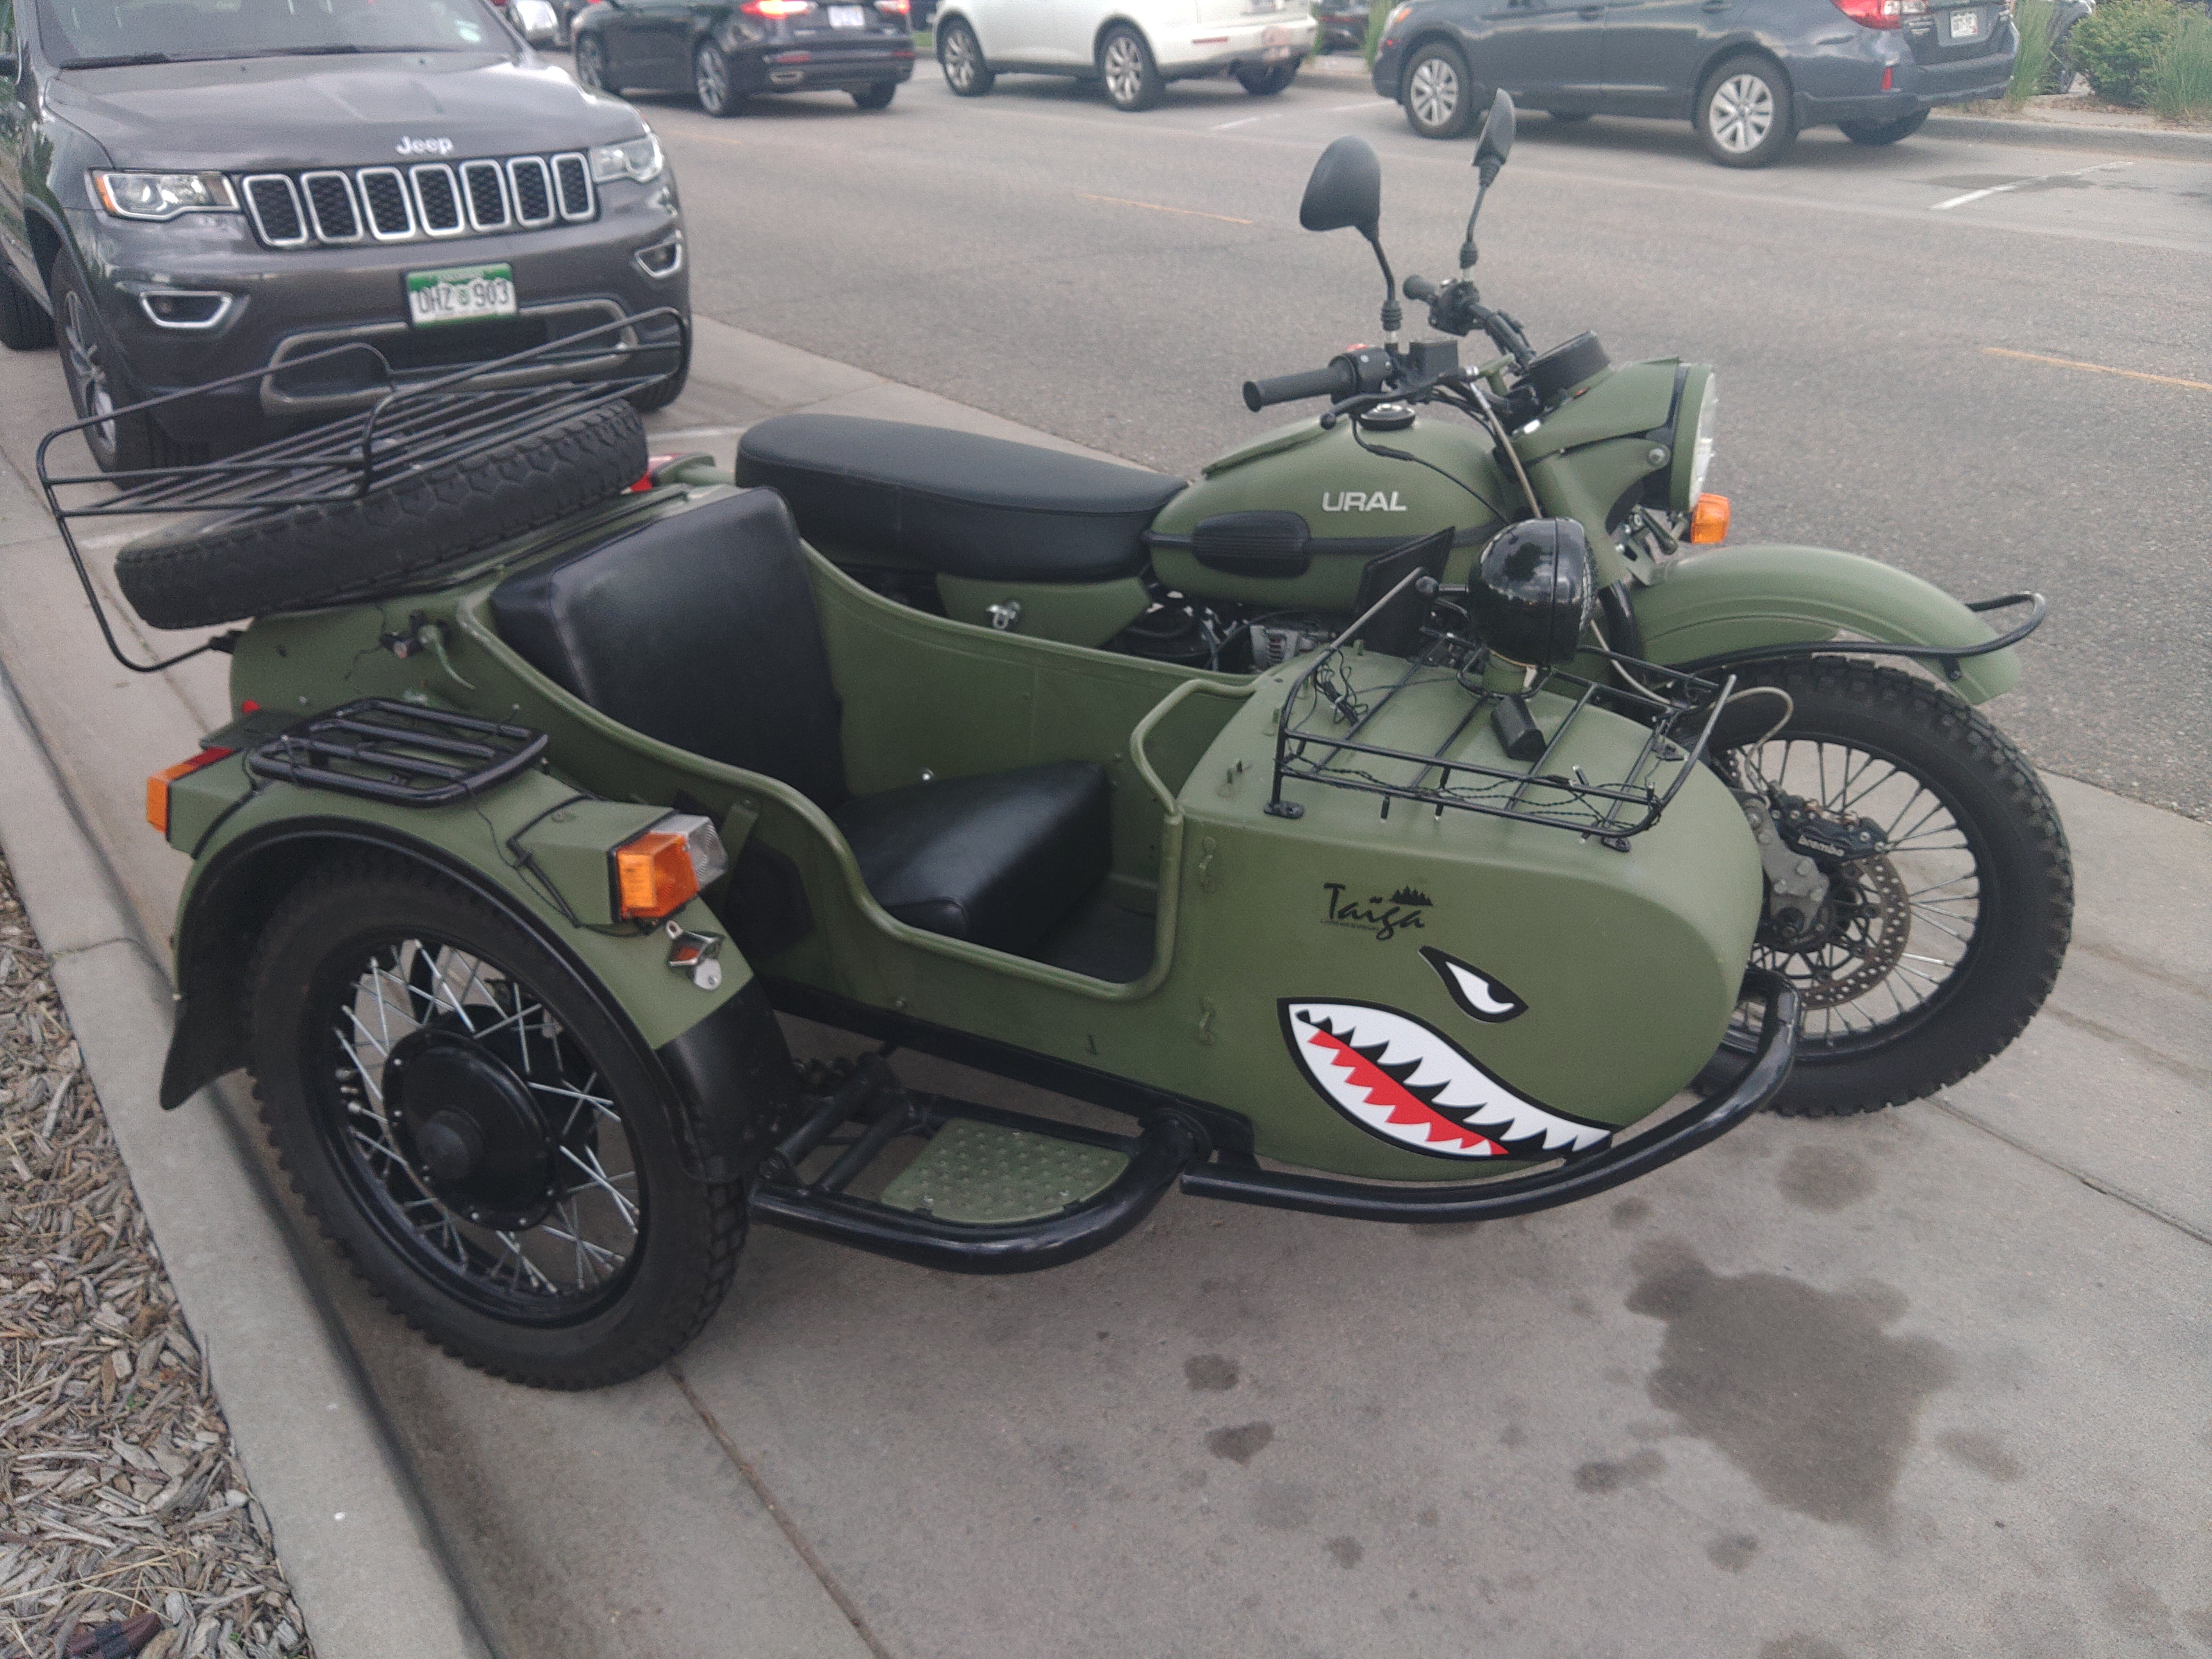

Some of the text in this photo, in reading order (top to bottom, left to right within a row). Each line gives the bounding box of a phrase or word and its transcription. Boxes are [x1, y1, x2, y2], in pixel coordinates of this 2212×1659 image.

[396, 136, 453, 155] Jeep
[1322, 491, 1407, 512] URAL
[1798, 835, 1845, 857] brembo
